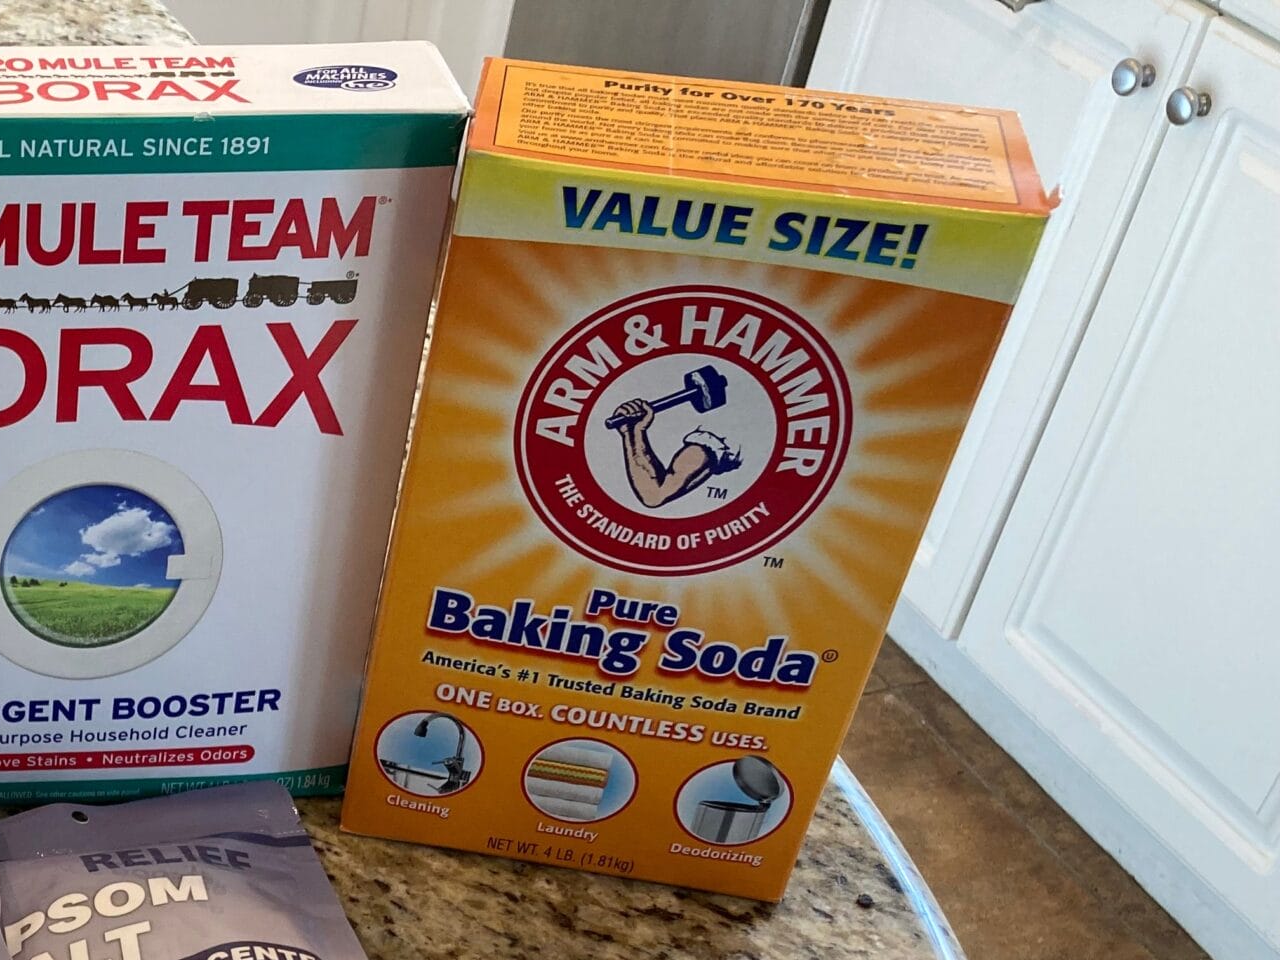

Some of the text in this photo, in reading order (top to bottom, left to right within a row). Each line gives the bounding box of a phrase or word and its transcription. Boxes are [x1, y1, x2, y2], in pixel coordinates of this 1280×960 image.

[38, 58, 137, 71] MULE
[140, 56, 235, 69] TEAM
[604, 80, 897, 117] Purity for Over 170 Years
[19, 138, 134, 158] NATURAL
[143, 137, 213, 157] SINCE
[221, 136, 270, 156] 1891
[182, 195, 378, 263] TEAM
[561, 185, 930, 270] VALUE SIZE!
[535, 304, 832, 478] ARM & HAMMER
[587, 588, 680, 627] Pure
[426, 586, 820, 687] Baking Soda
[421, 650, 802, 721] America's #1 Trusted Baking Soda Brand
[112, 688, 282, 721] BOOSTER
[435, 682, 770, 752] ONE BOX. COUNTLESS USES.
[70, 726, 169, 743] Household
[175, 724, 248, 739] Cleaner
[26, 755, 77, 767] Stains
[102, 752, 195, 766] Neutralizes
[200, 749, 248, 762] Odors
[385, 794, 452, 819] Cleaning
[536, 822, 600, 844] Laundry
[79, 844, 254, 873] RELIEF
[486, 836, 635, 873] NET WT. 4 LB. (1.81kg)
[669, 841, 765, 868] Deodorizing
